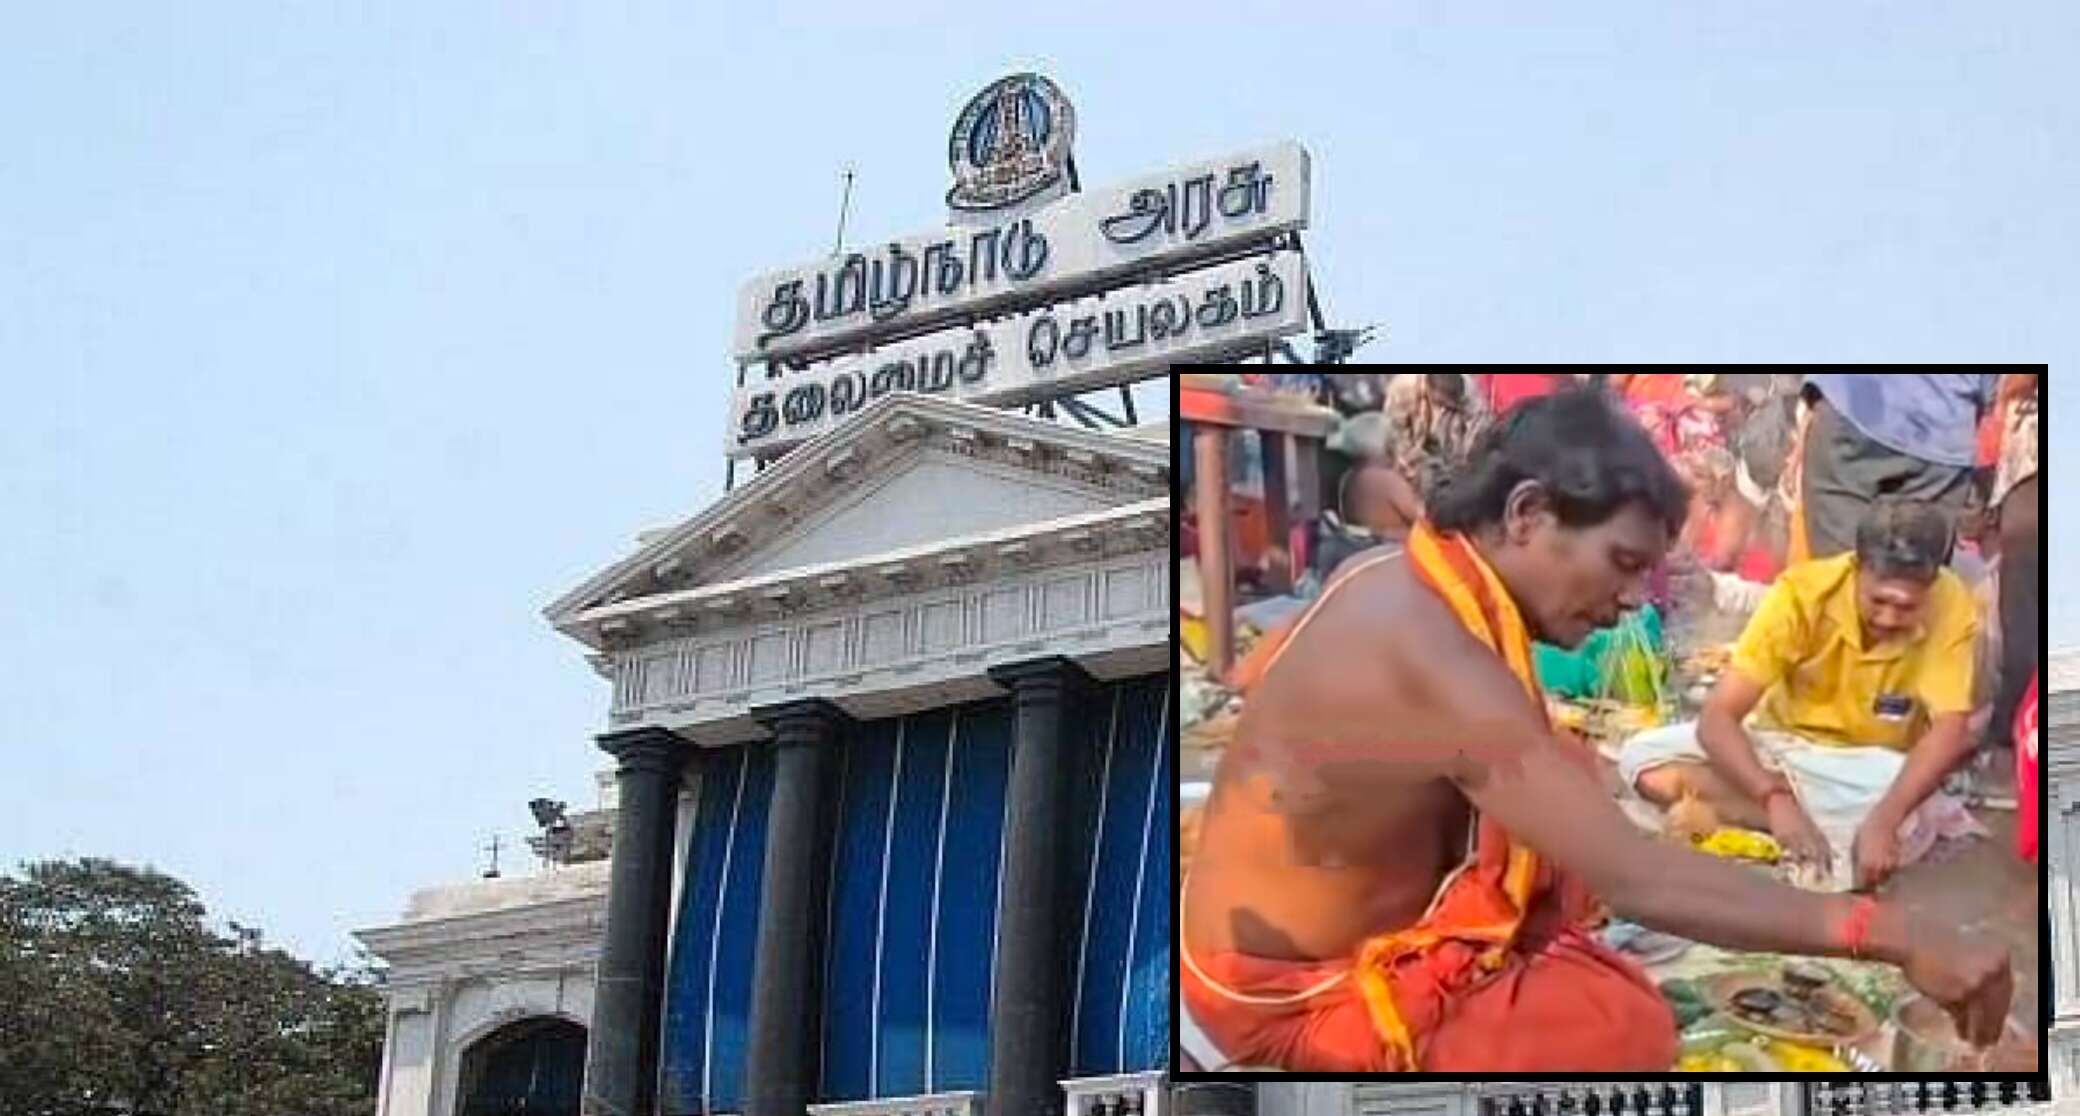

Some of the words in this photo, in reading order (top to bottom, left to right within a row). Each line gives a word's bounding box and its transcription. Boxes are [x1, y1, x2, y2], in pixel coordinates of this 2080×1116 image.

[758, 218, 1048, 349] தமிழ்நாடு
[1100, 160, 1274, 243] அரசு
[738, 329, 995, 444] தலைமைச்
[1028, 263, 1283, 369] செயலகம்
